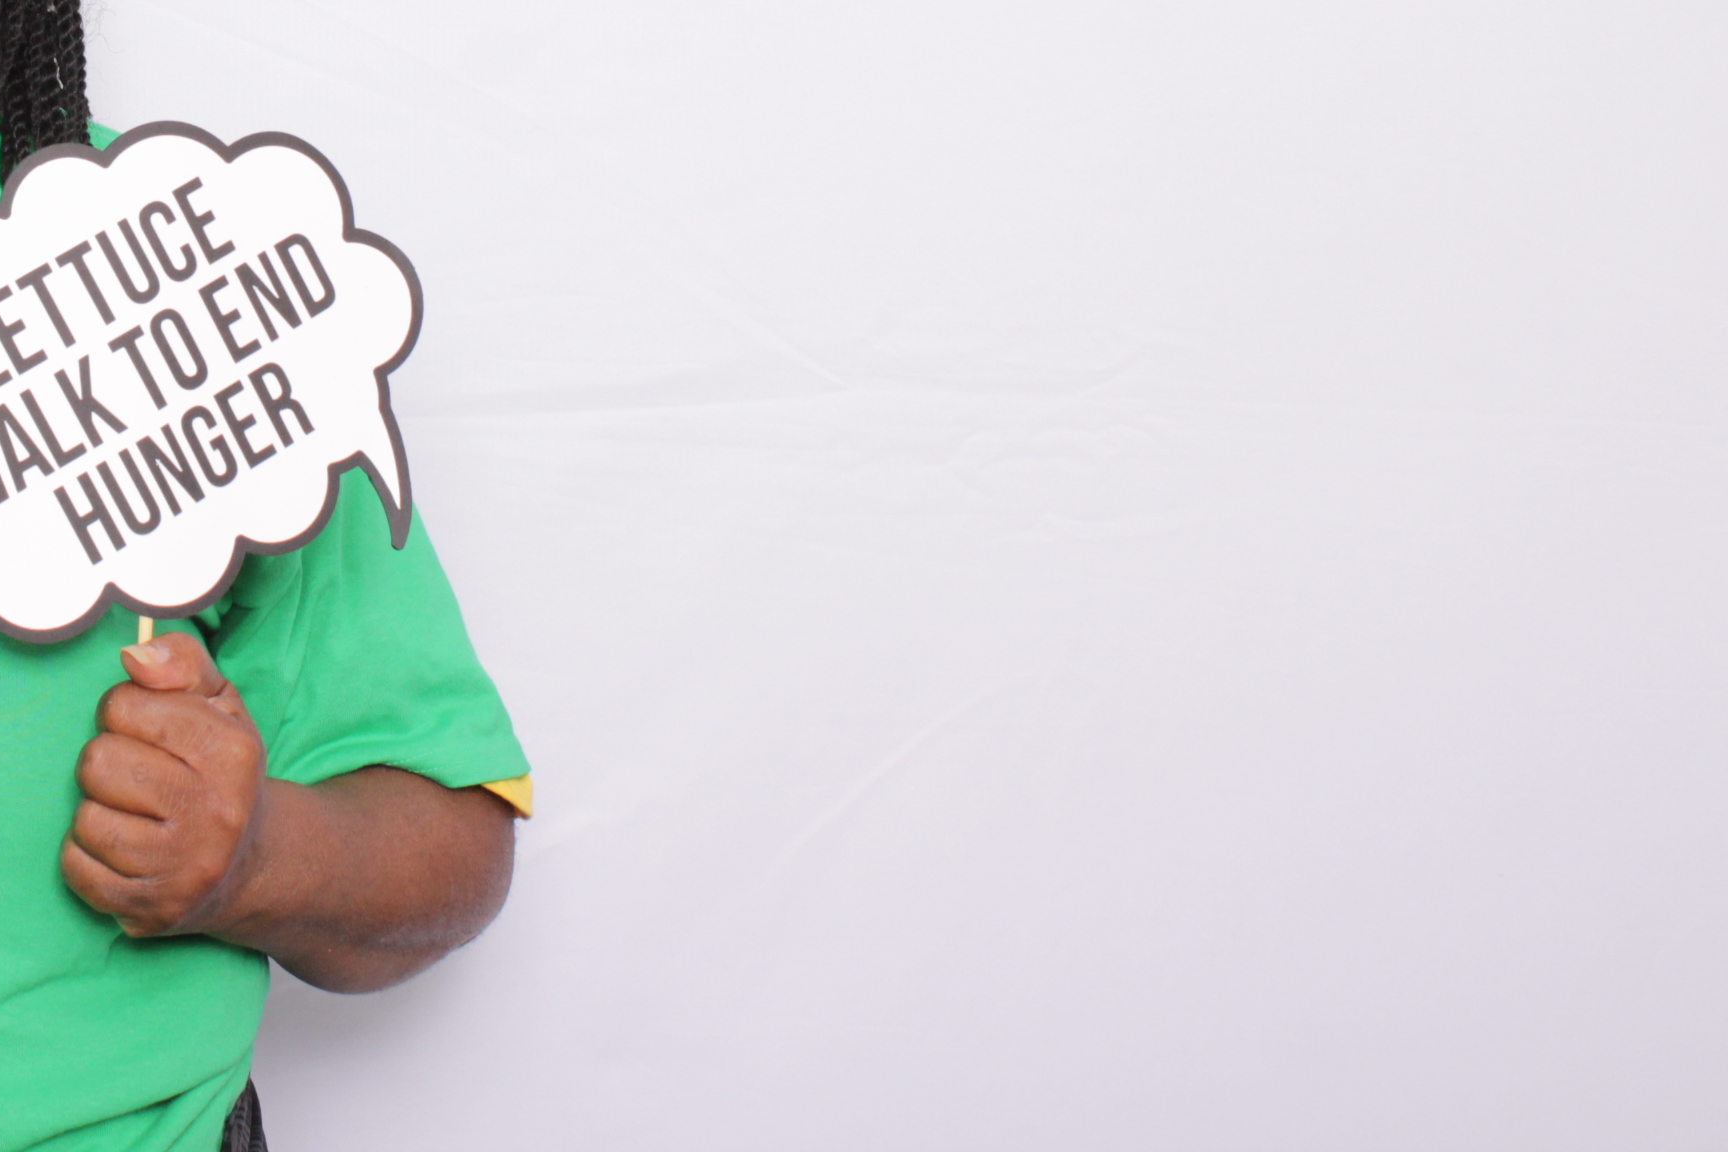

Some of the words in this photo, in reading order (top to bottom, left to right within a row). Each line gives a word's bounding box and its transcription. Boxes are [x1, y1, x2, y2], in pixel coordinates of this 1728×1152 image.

[108, 309, 209, 410] TO
[198, 233, 336, 364] END
[53, 362, 316, 566] HUNGER
